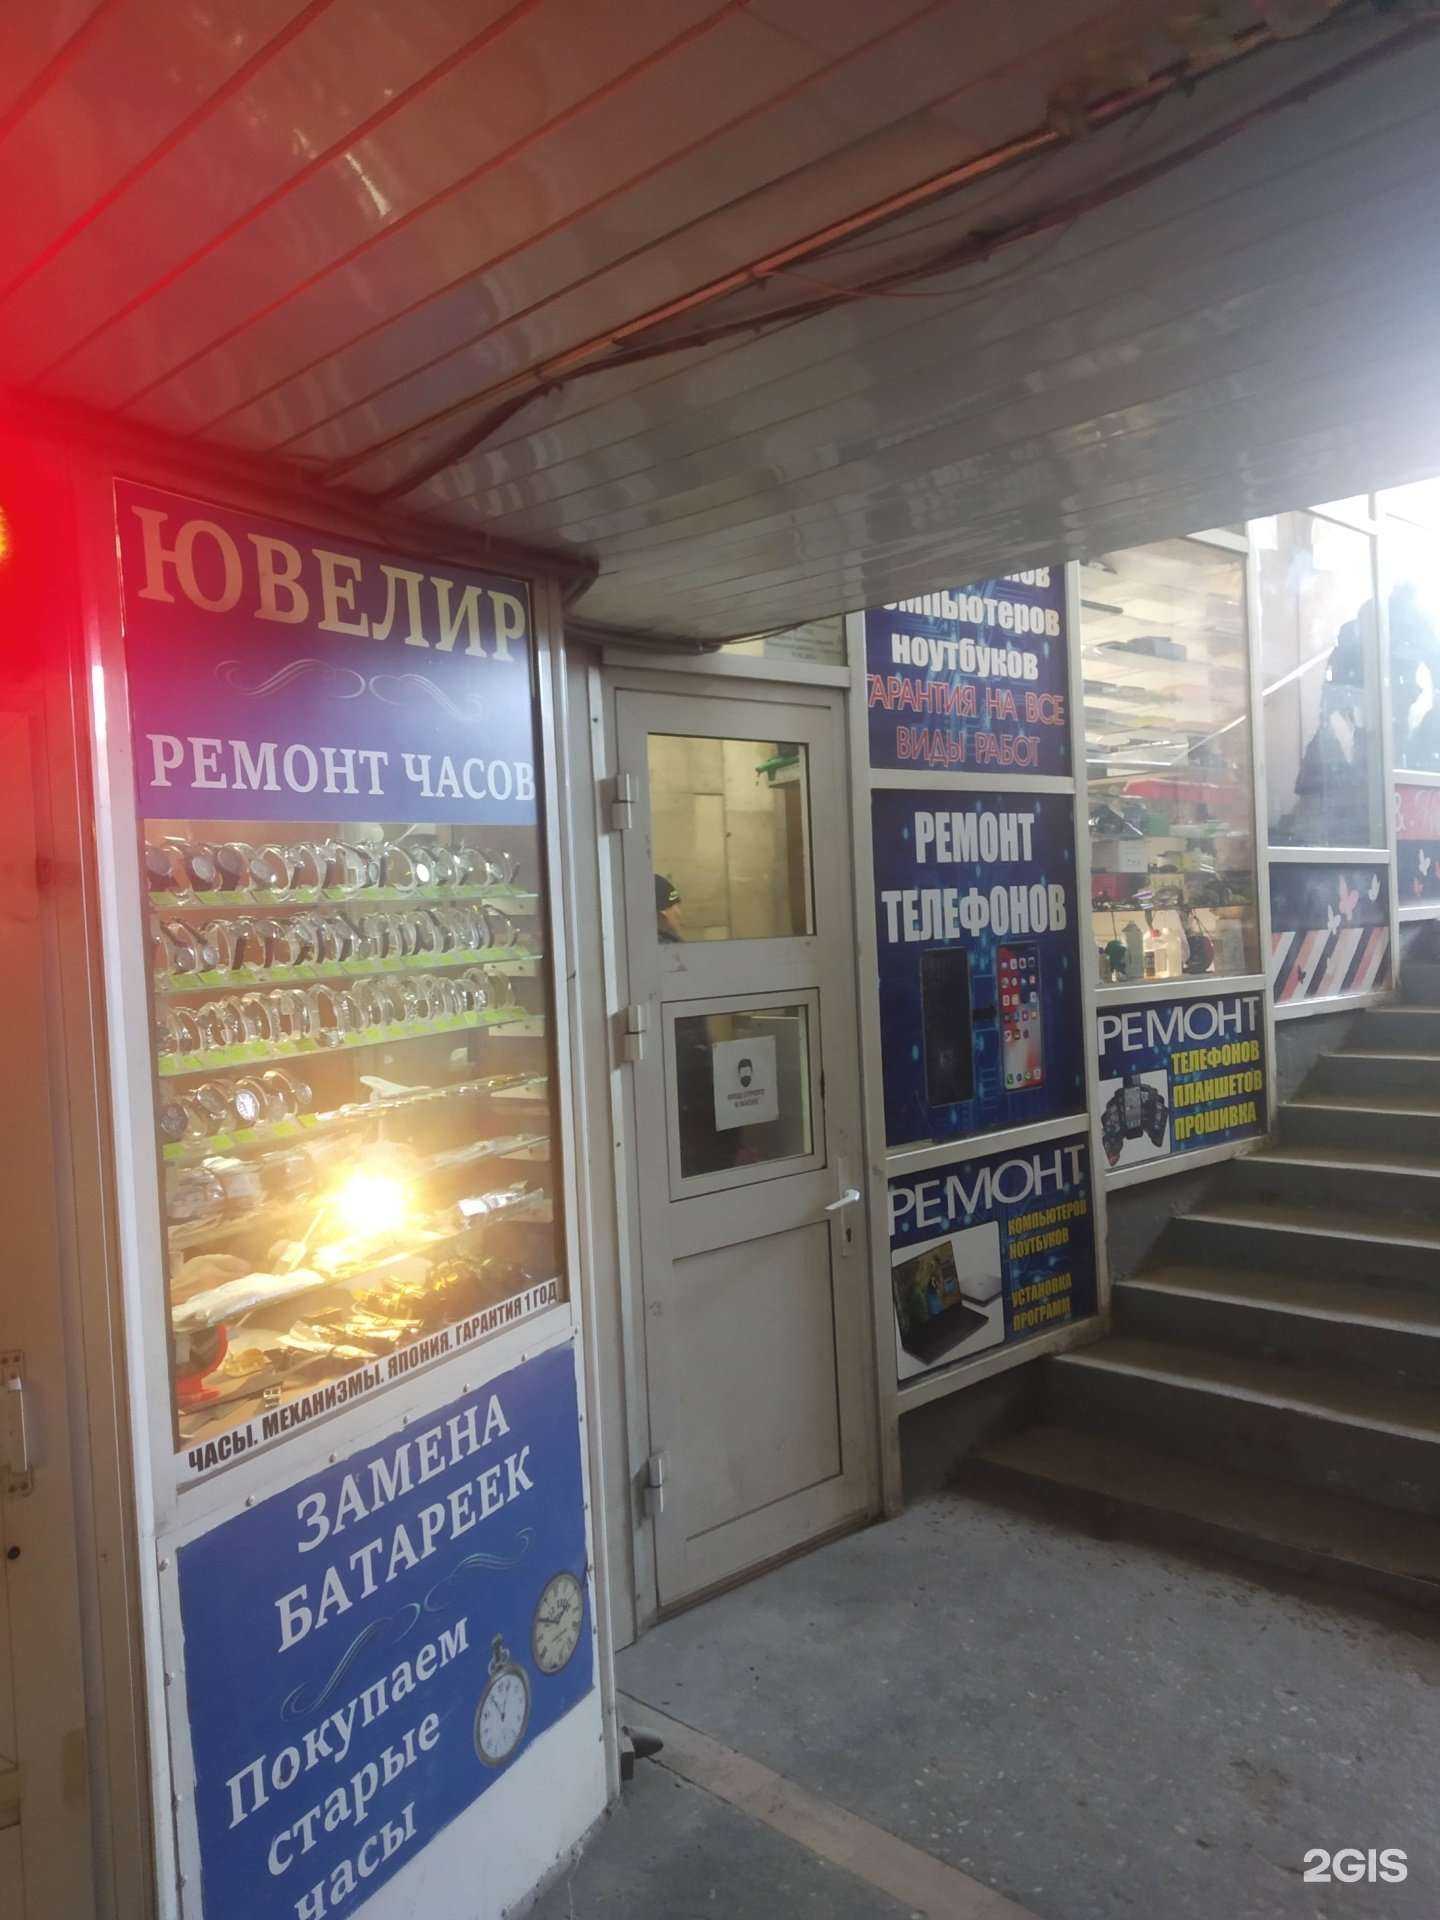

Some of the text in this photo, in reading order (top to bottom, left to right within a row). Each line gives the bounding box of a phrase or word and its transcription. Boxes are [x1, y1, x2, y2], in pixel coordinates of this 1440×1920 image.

[131, 504, 526, 662] ЮВЕЛИР
[882, 590, 1060, 637] мпьютеров
[891, 633, 1039, 681] ноутбуков
[986, 687, 1018, 722] НА
[1025, 691, 1065, 726] ВСЕ
[146, 733, 536, 801] РЕМОНТ ЧАСОВ
[896, 726, 1041, 768] ВИДЫ РАБОТ
[914, 811, 1035, 864] РЕМОНТ
[881, 883, 1068, 944] ТЕЛЕФОНОВ
[1097, 996, 1260, 1056] РЕМОНТ
[1170, 1039, 1260, 1076] ТЕЛЕФОНОВ
[1173, 1070, 1263, 1108] ПЛАНШЕТОВ
[1174, 1101, 1257, 1141] ПРОШИВКА
[888, 1144, 1085, 1237] РЕМОНТ
[1007, 1199, 1087, 1236] КОМПЬЮТЕРОВ
[1008, 1226, 1070, 1260] НОУТБУКОВ
[1011, 1272, 1073, 1308] УСТАНОВКА
[1012, 1296, 1072, 1332] ПРОГРАММ
[188, 1280, 559, 1473] ЧАСЫ. МЕХАНИЗМЫ. ЯПОНИЯ. ГАРАНТИЯ 1 ГОД
[296, 1394, 511, 1553] ЗАМЕНА
[275, 1446, 533, 1653] БАТАРЕЕК
[225, 1617, 470, 1829] Покупаем
[267, 1713, 441, 1876] старые
[294, 1801, 416, 1920] часы
